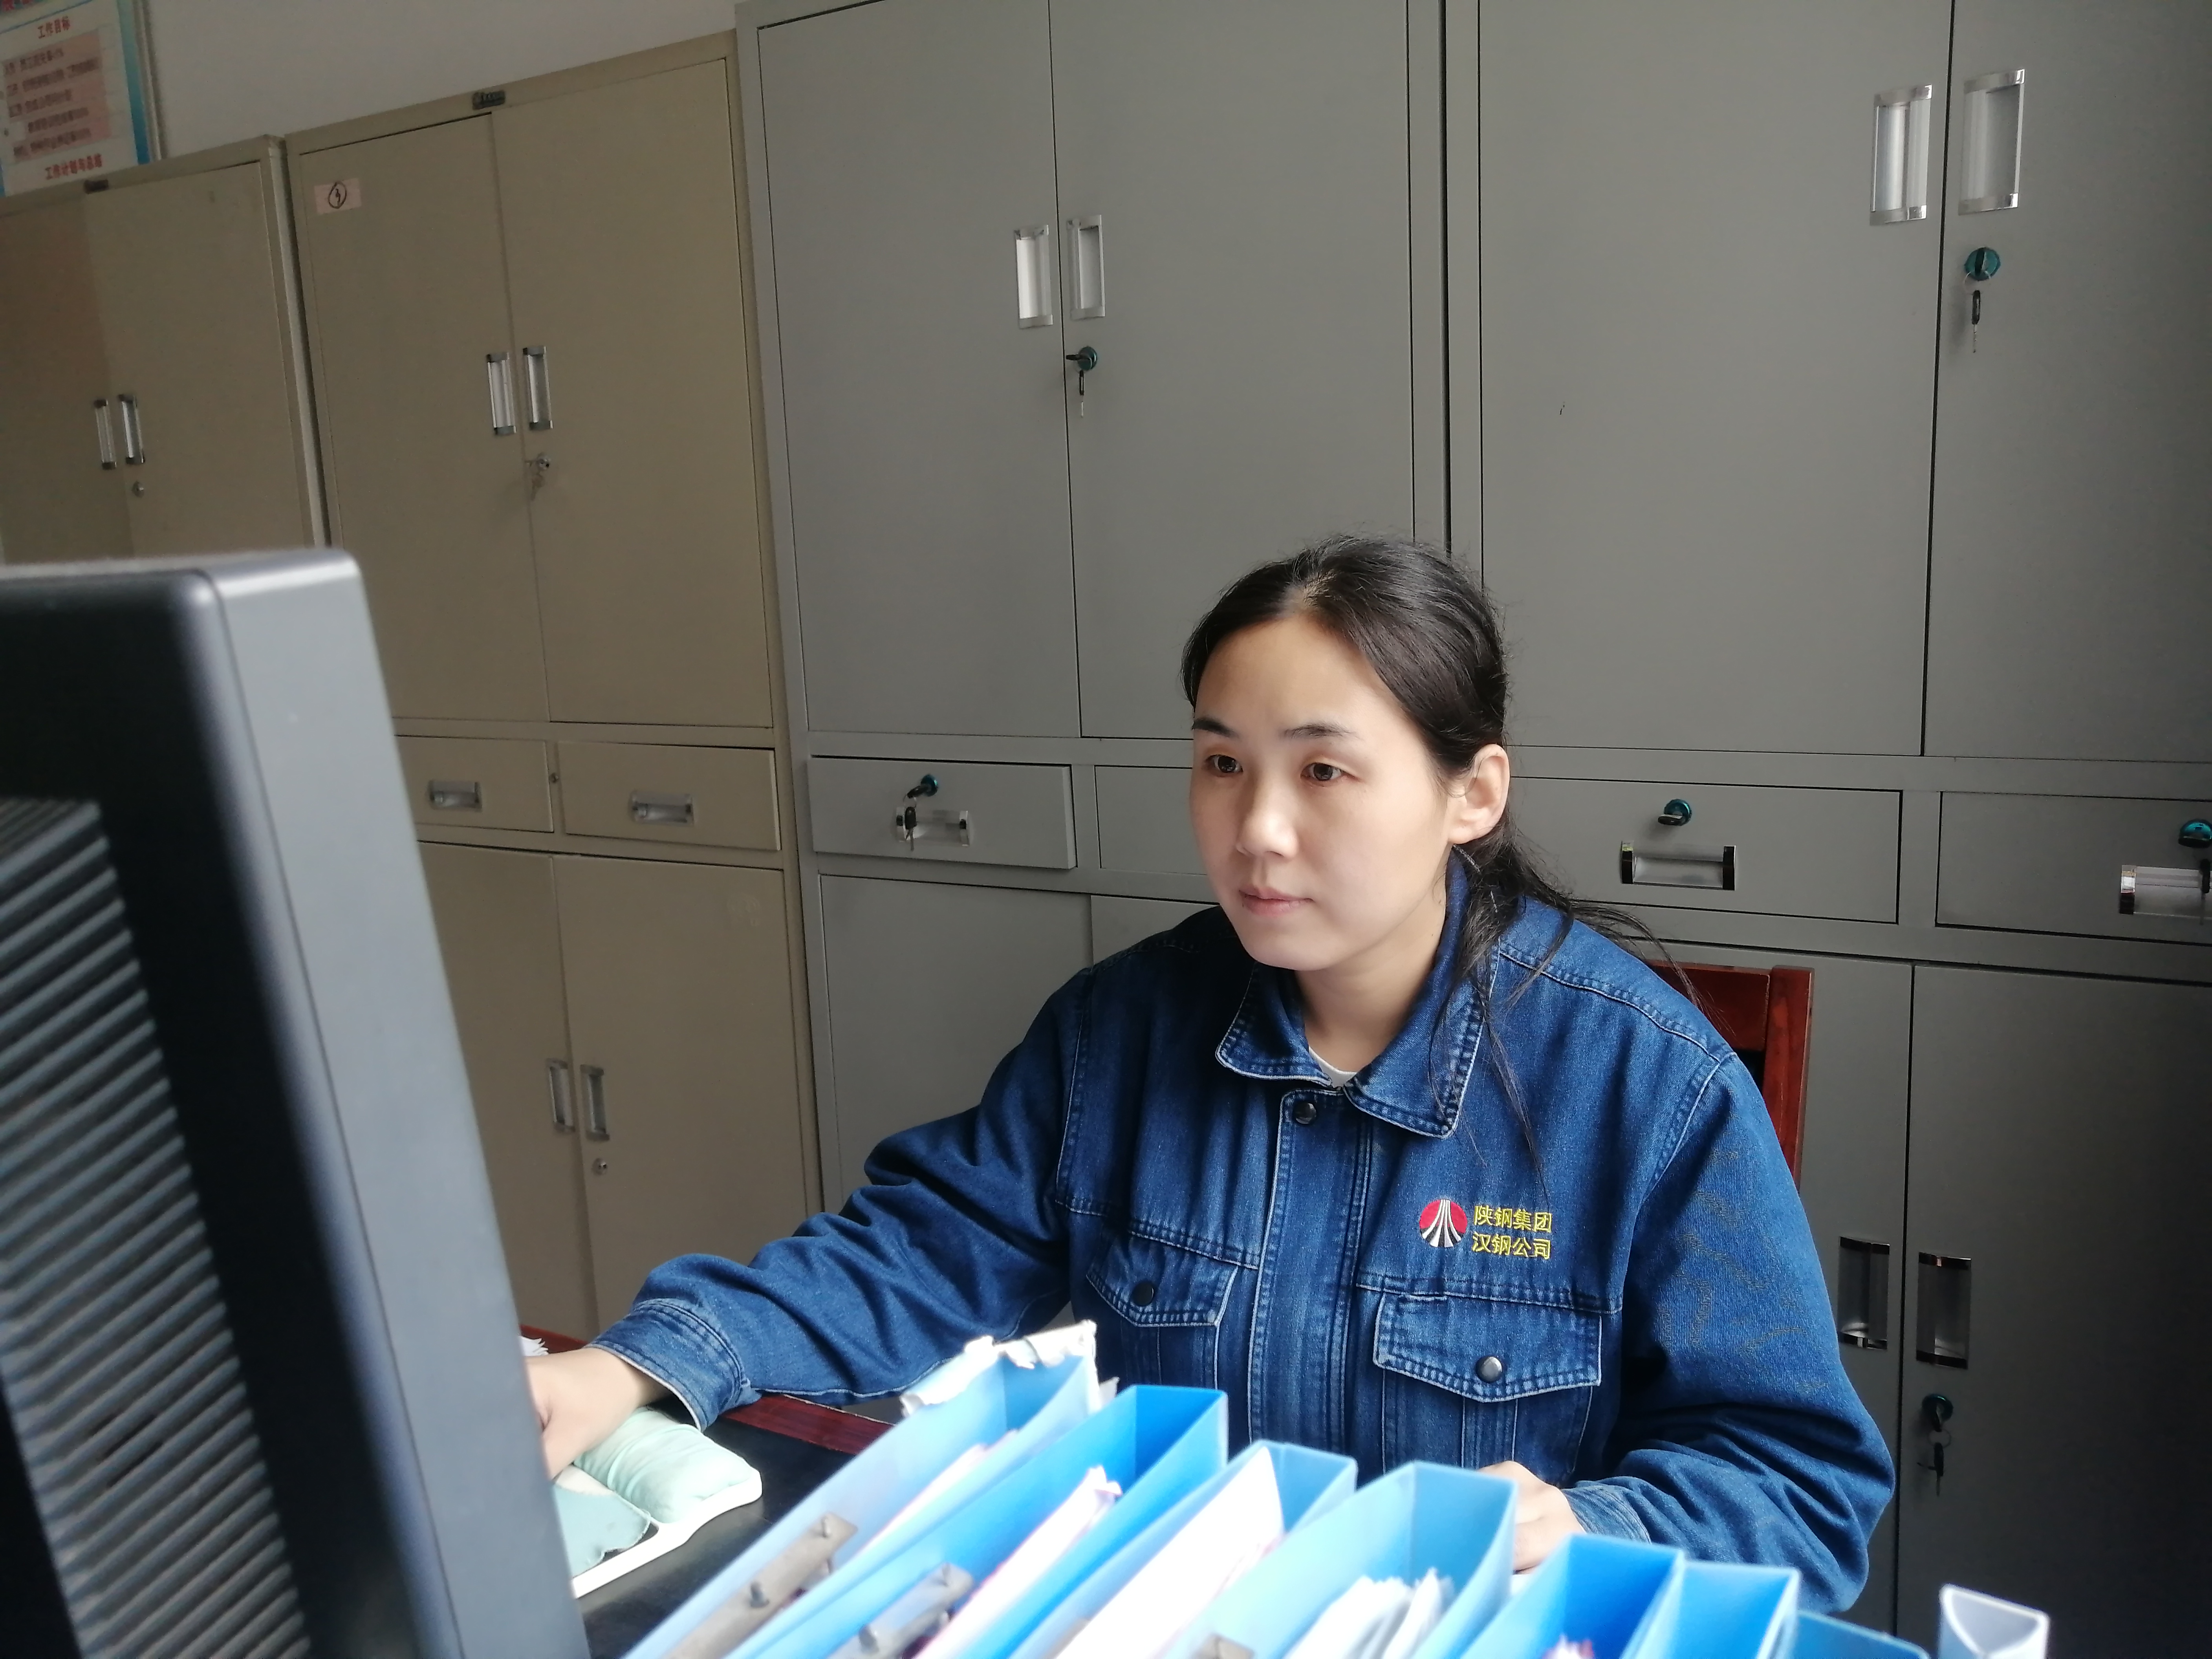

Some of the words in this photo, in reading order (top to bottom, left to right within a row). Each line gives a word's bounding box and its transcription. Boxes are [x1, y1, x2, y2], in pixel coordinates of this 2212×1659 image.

[1474, 1205, 1552, 1232] 陕钢集团
[1472, 1232, 1551, 1260] 汉钢公司
